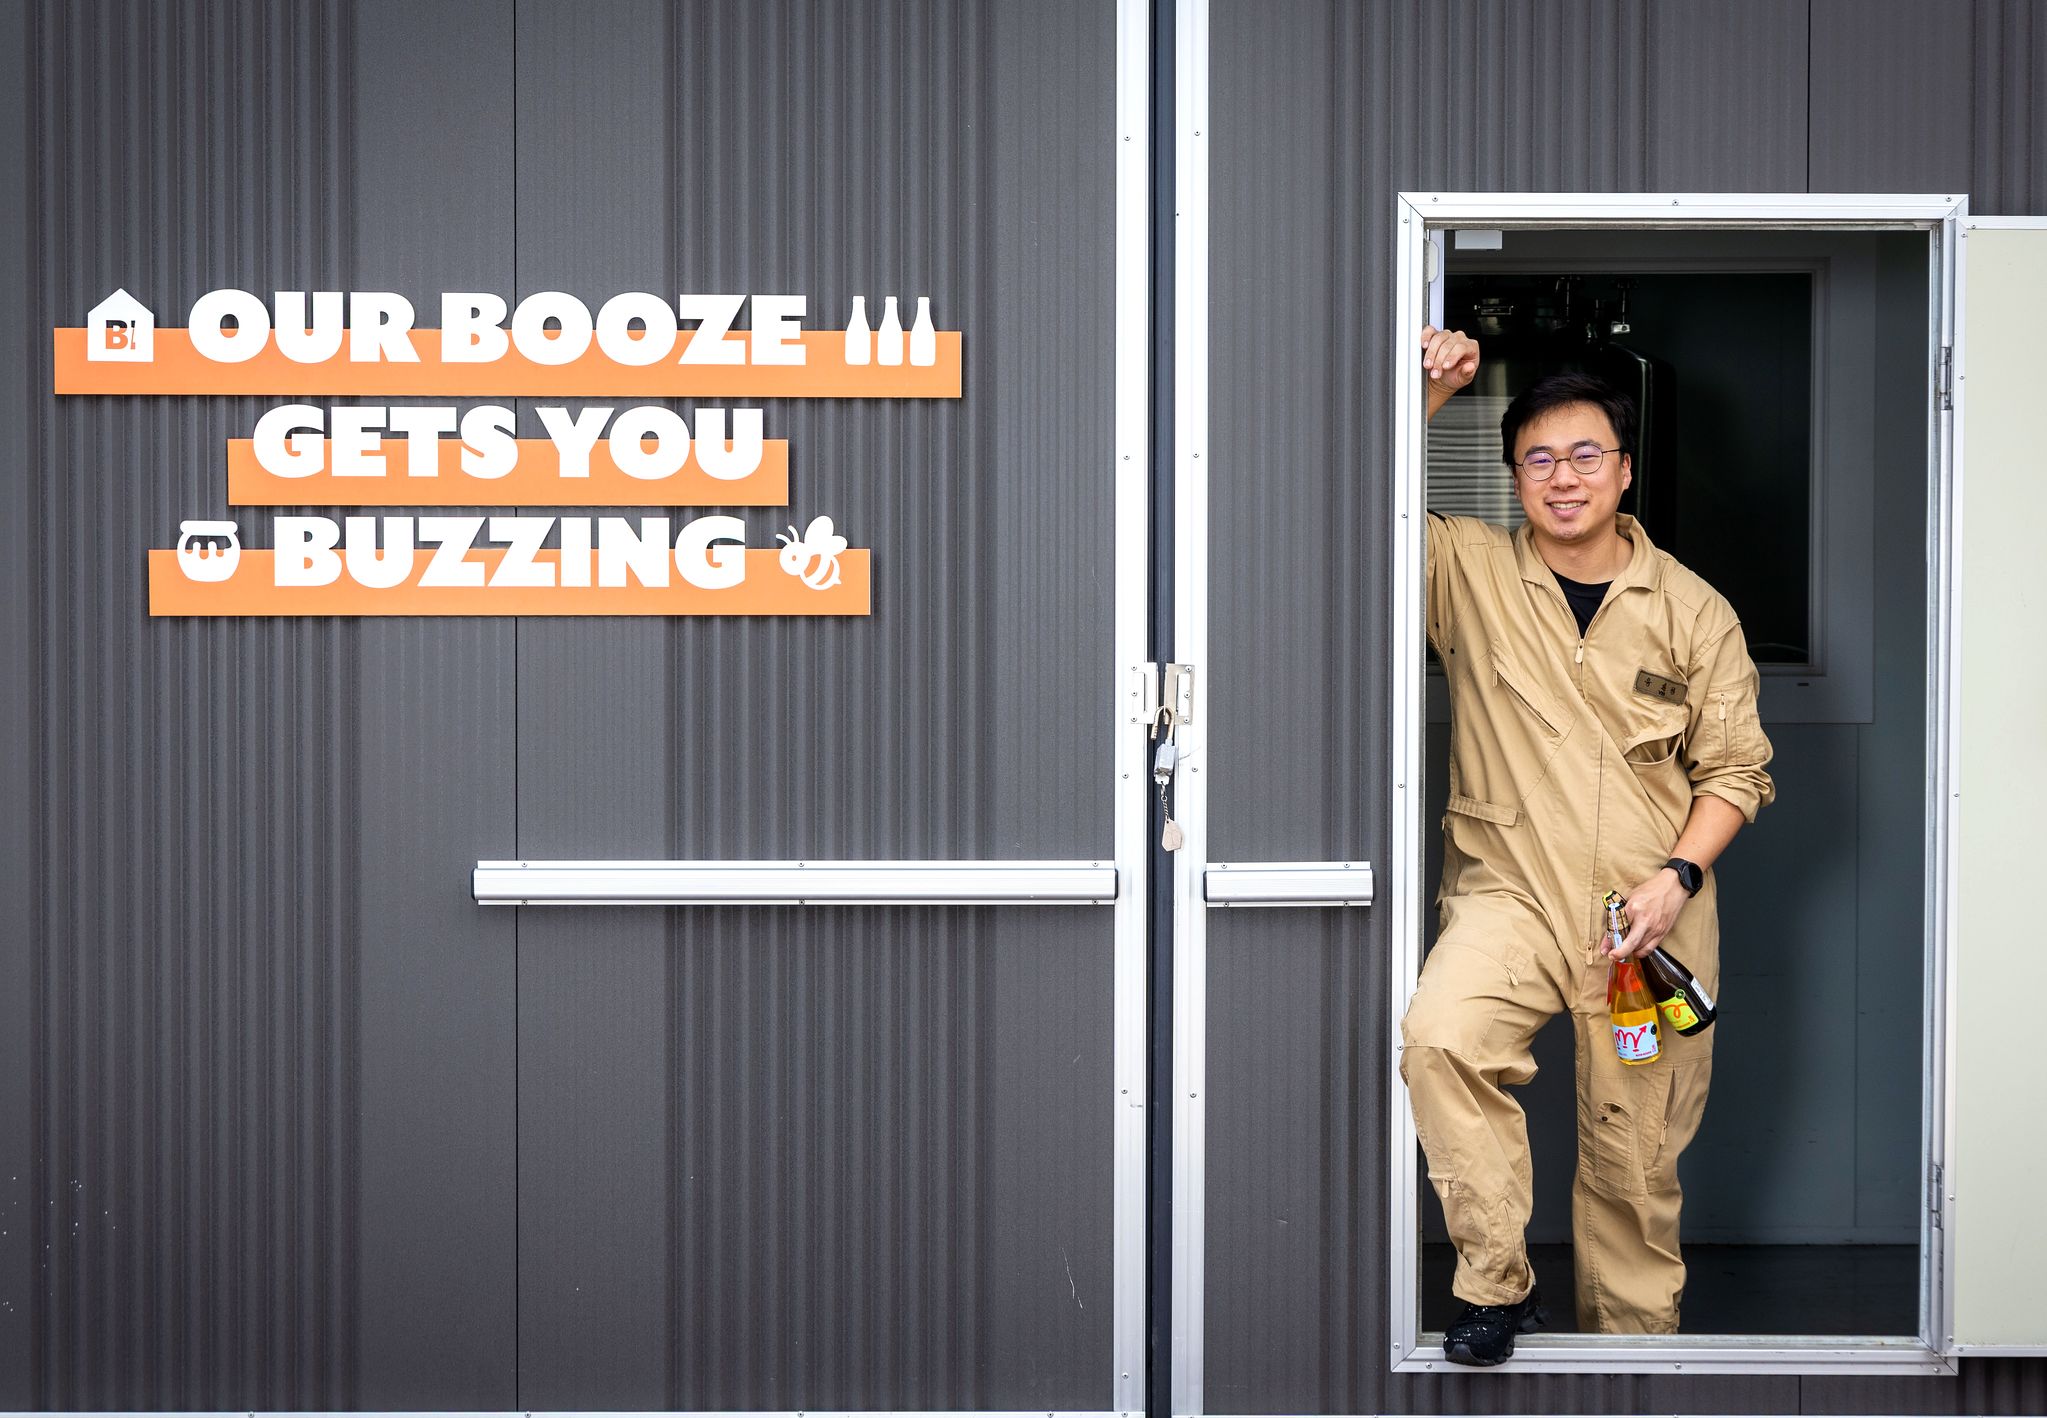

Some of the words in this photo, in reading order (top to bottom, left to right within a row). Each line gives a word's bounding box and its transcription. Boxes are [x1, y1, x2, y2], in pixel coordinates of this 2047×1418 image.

[188, 288, 421, 364] OUR
[441, 291, 806, 367] BOOZE
[253, 404, 519, 480] GETS
[535, 405, 763, 481] YOU
[274, 515, 746, 590] BUZZING
